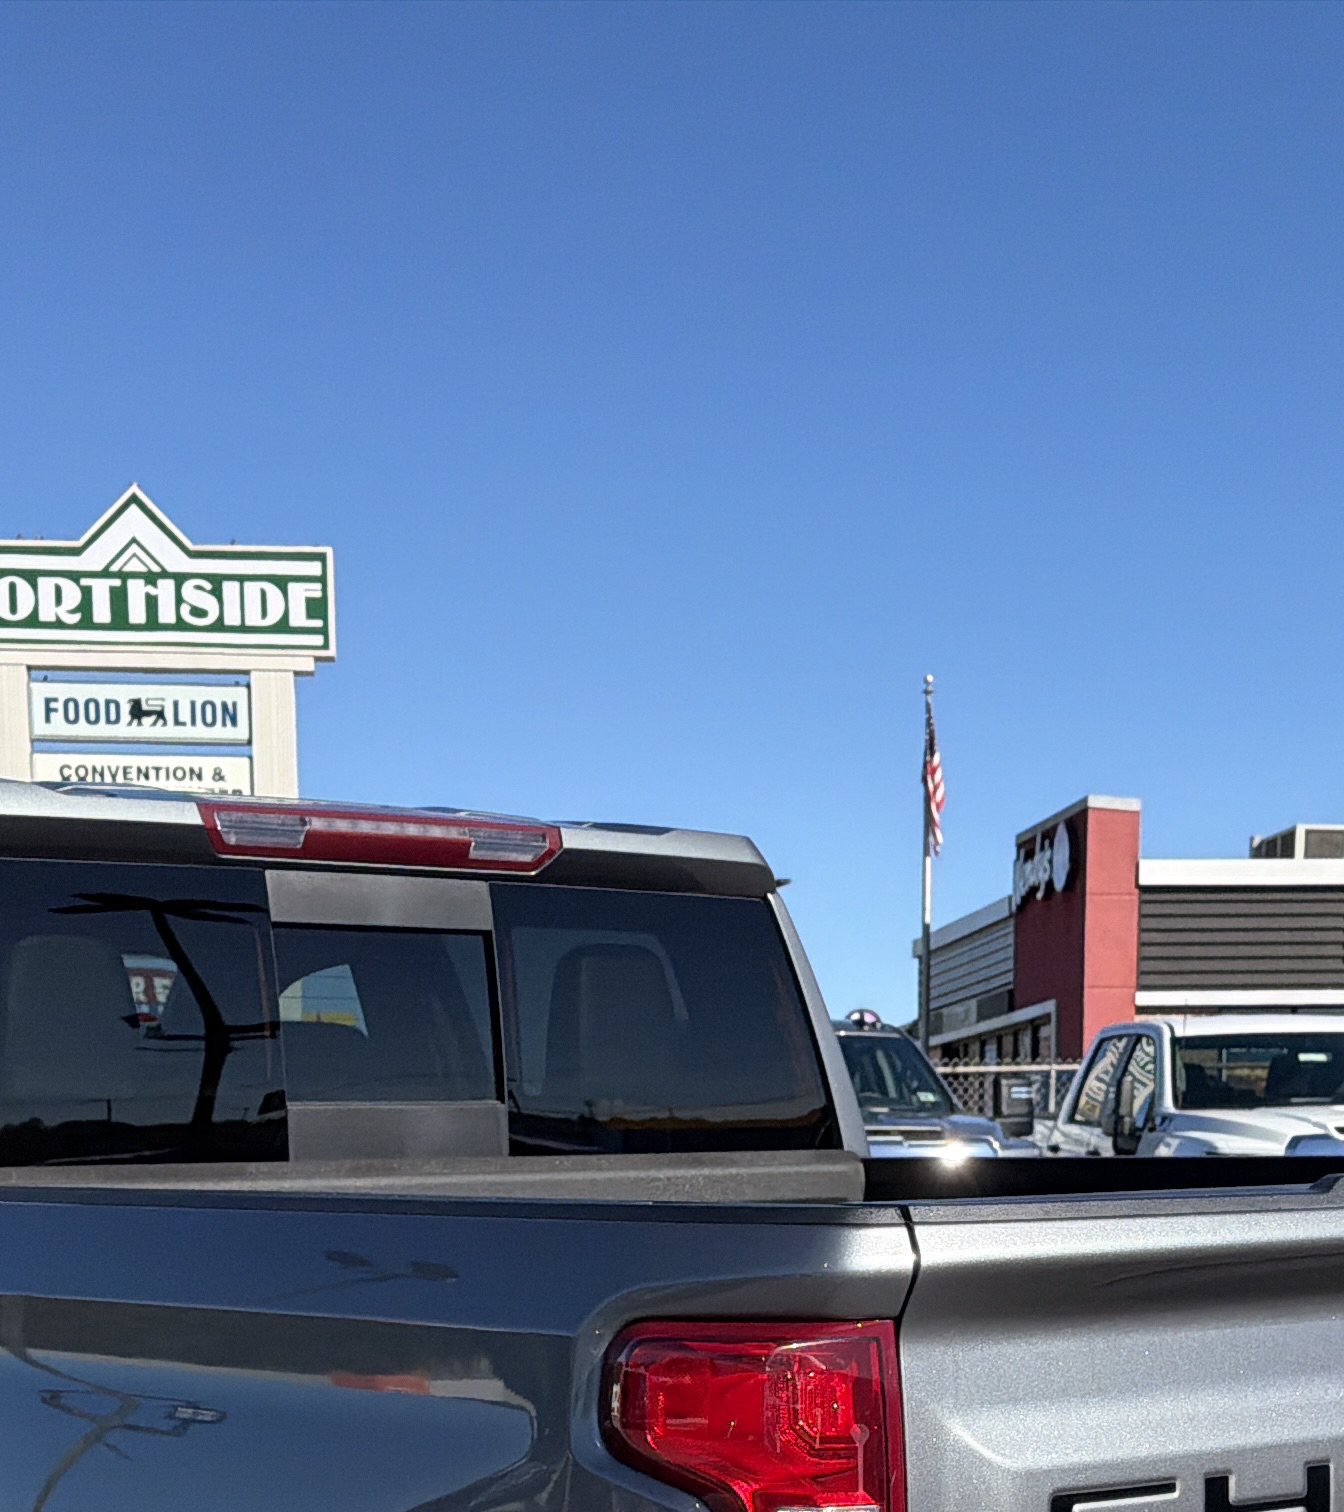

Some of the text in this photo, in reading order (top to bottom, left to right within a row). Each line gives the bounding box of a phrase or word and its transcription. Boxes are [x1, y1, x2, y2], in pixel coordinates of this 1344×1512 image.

[44, 696, 239, 728] FOOD LION
[58, 763, 227, 783] CONVENTION &
